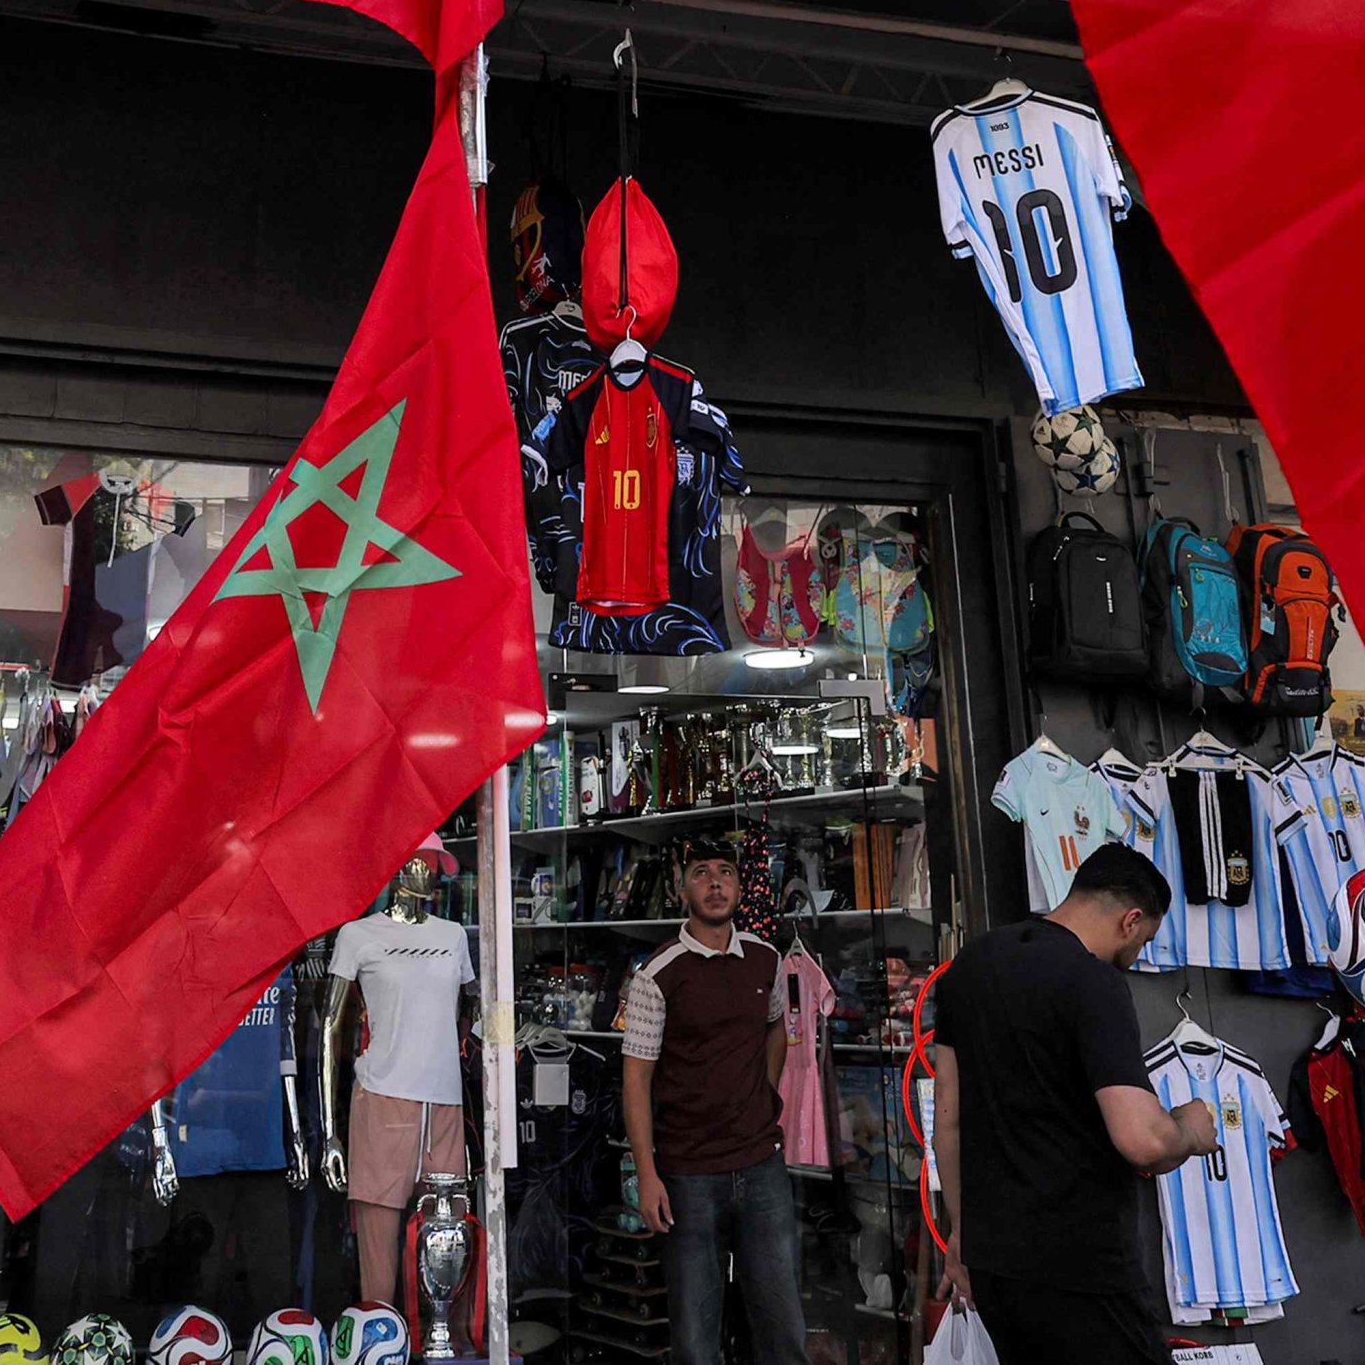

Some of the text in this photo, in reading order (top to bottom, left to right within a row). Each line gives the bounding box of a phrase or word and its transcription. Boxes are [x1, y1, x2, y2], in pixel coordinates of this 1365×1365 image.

[972, 143, 1045, 180] MESSI
[981, 188, 1079, 304] 10
[613, 469, 641, 511] 10
[1328, 829, 1353, 863] 10
[519, 1120, 536, 1145] 10
